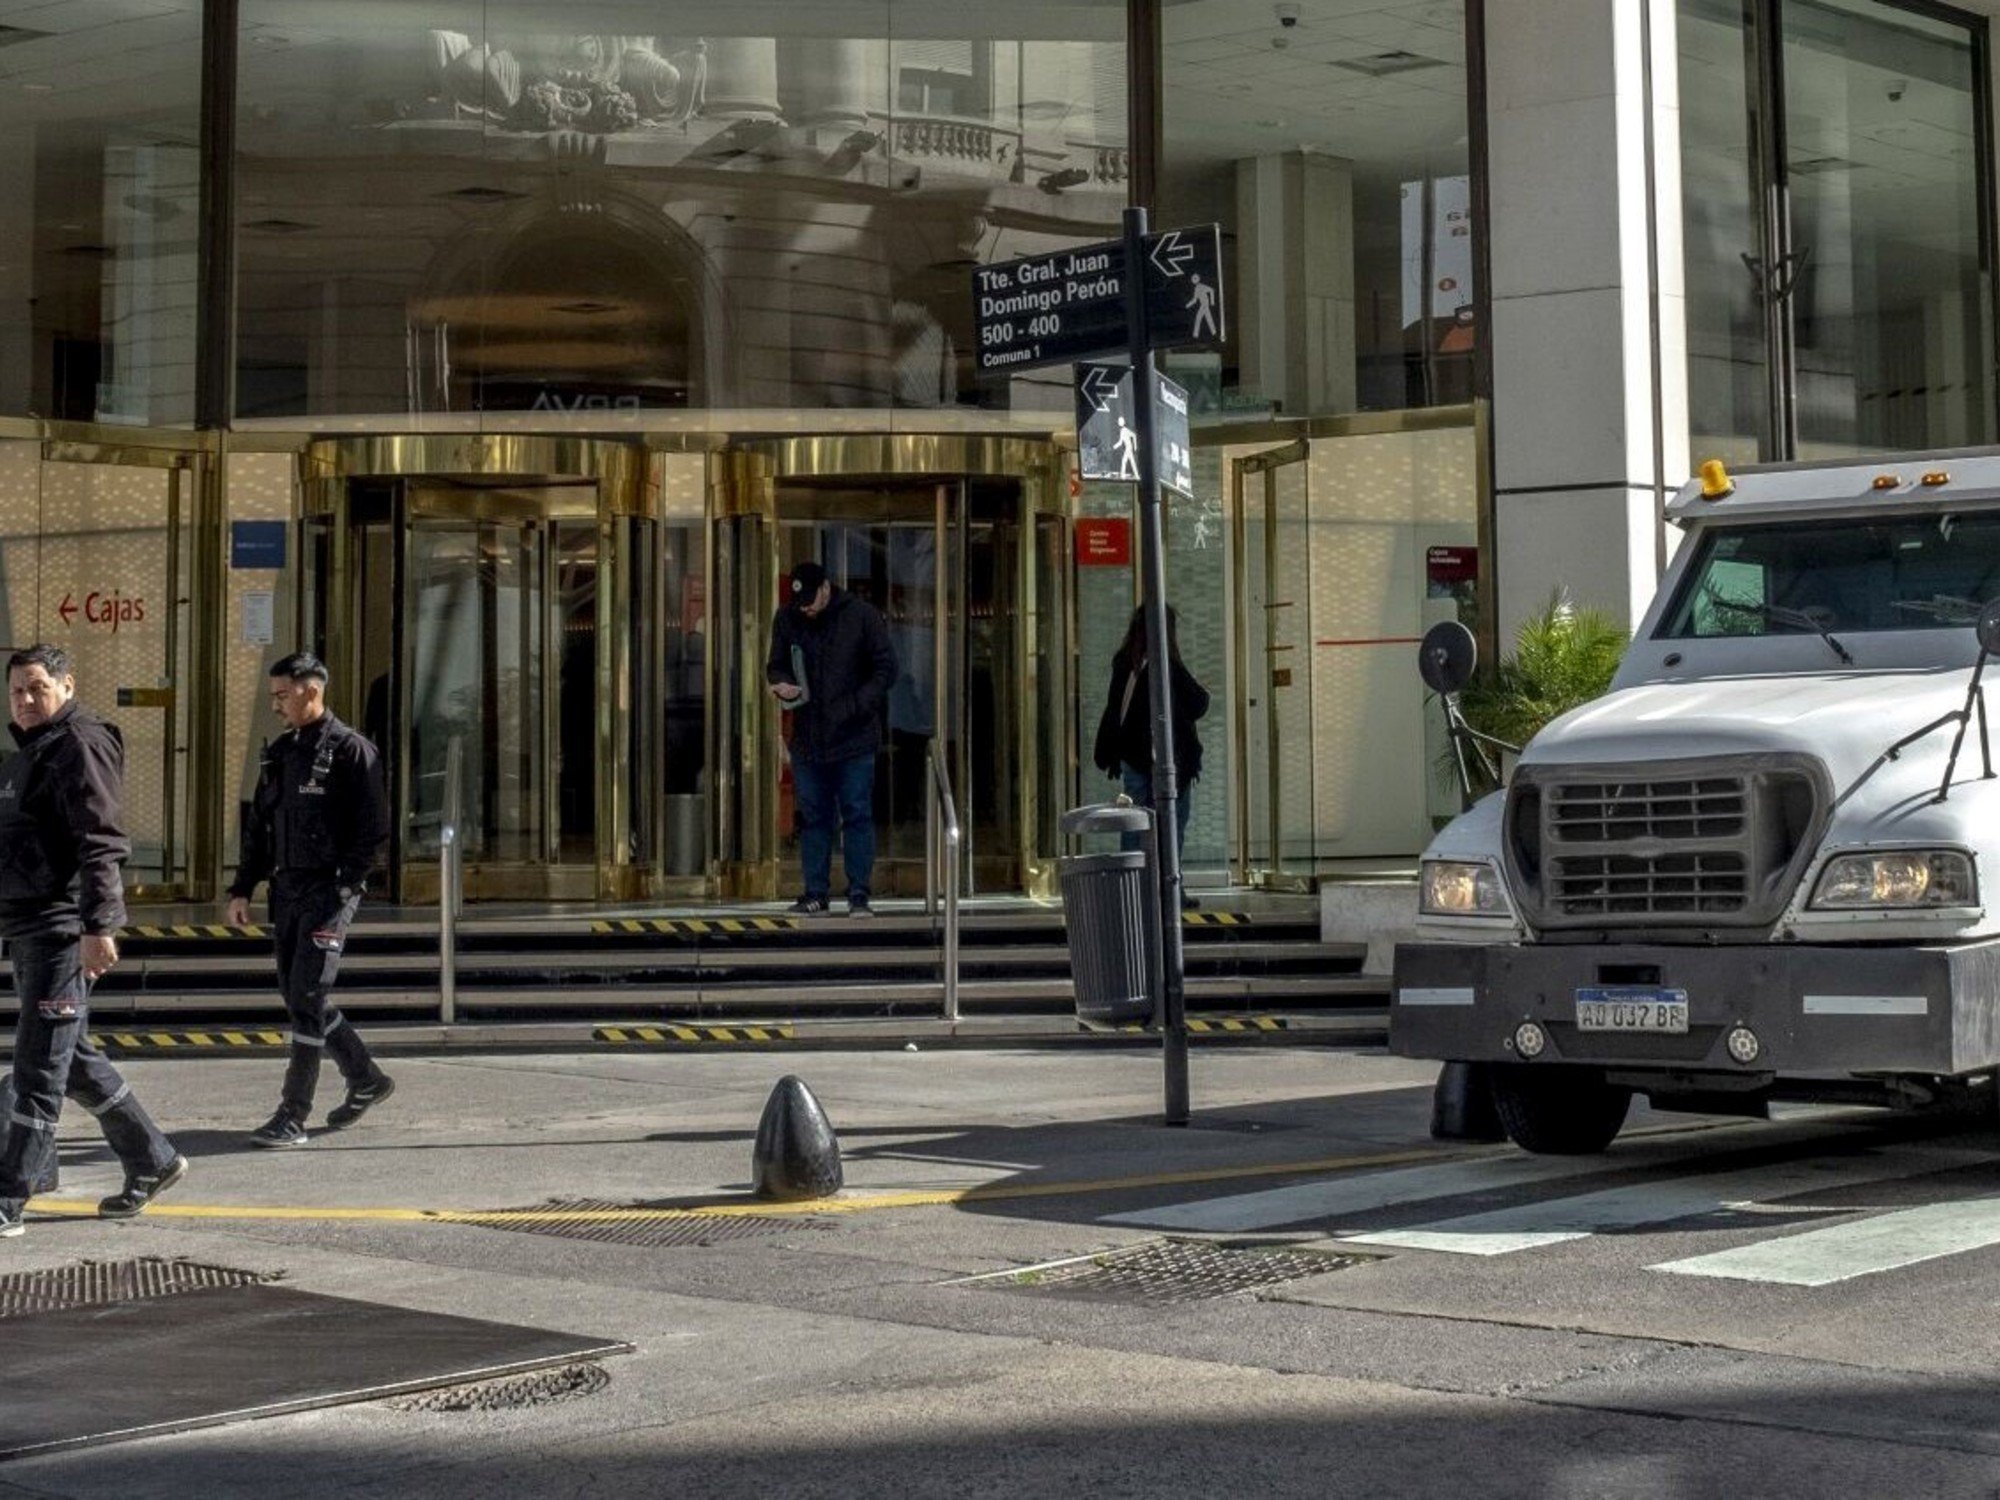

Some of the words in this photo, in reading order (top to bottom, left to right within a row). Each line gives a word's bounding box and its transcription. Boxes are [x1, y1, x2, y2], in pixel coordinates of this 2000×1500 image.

[979, 270, 1014, 292] Tte.
[1017, 262, 1060, 285] Gral.
[1064, 253, 1109, 276] Juan
[981, 289, 1061, 317] Domingo
[1066, 276, 1119, 302] Perón
[982, 324, 1013, 345] 500
[1028, 314, 1060, 337] 400
[983, 348, 1031, 367] Comuna
[1034, 345, 1041, 359] 1
[85, 589, 144, 634] Cajas
